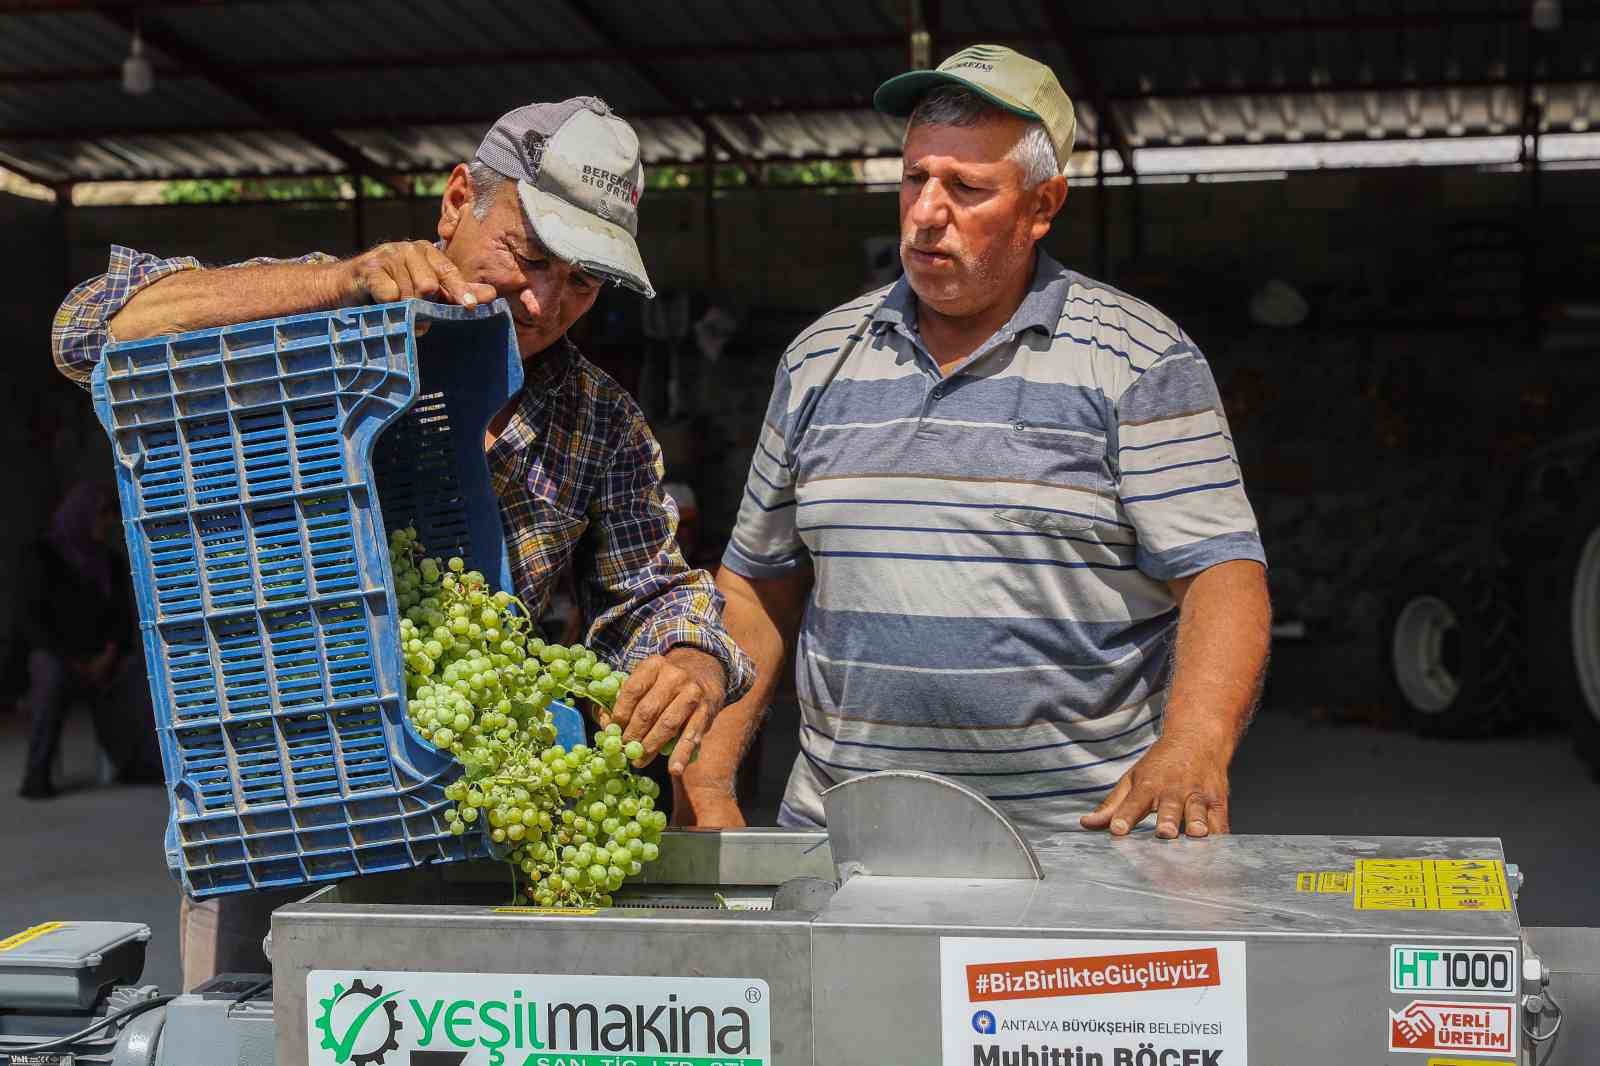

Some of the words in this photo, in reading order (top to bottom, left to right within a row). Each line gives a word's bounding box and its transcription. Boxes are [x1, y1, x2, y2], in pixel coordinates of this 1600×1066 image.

[975, 960, 1209, 994] #BizBirlikteGüçlüyüz
[1001, 1019, 1059, 1032] ANTALYA
[1062, 1019, 1145, 1036] BÜYÜKŞEHİR
[1149, 1022, 1223, 1036] BELEDİYESİ
[1439, 1012, 1490, 1029] YERLİ
[1438, 1028, 1505, 1047] ÜRETİM
[973, 1044, 1104, 1066] Muhittin
